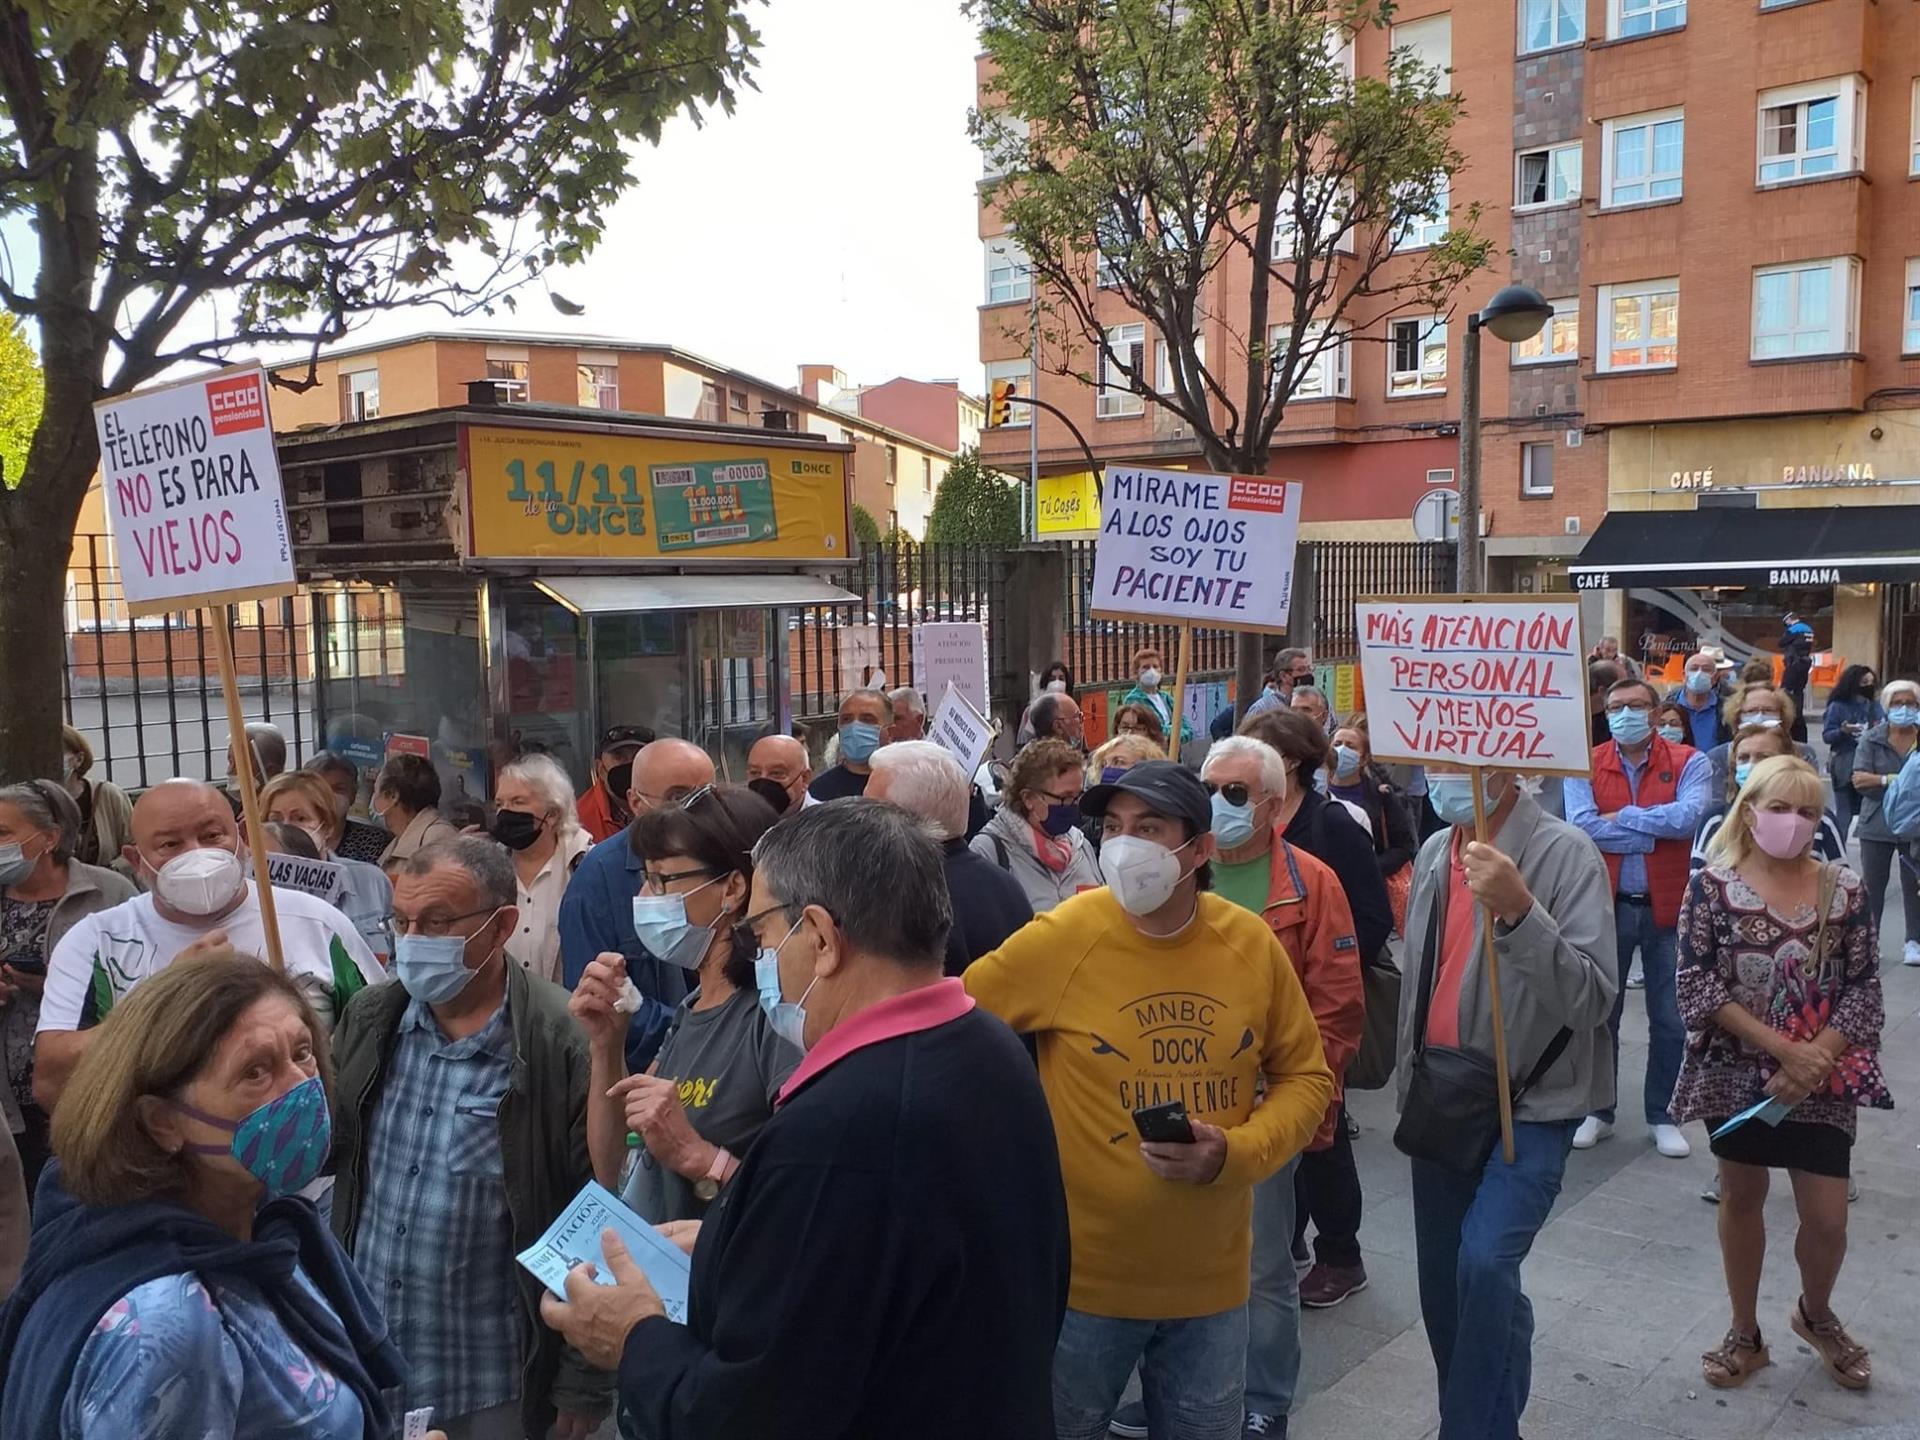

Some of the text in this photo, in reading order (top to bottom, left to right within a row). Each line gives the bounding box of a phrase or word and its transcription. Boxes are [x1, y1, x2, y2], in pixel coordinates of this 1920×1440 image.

[210, 387, 259, 411] CCOO
[104, 411, 125, 438] EL
[214, 408, 261, 425] pensionistas
[104, 415, 207, 471] TELÉFONO
[505, 458, 645, 505] 11/11
[803, 461, 832, 475] ONCE
[1670, 463, 1874, 489] CAFÉ BANDANA
[116, 448, 260, 517] NO ES PARA
[1113, 472, 1219, 511] MÍRAME
[1232, 480, 1283, 497] CCOO
[524, 491, 560, 516] de la
[1231, 494, 1282, 507] pensionistas
[547, 504, 647, 536] ONCE
[1105, 508, 1247, 544] A LOS OJOS
[132, 509, 242, 578] VIEJOS
[1150, 546, 1247, 572] SOY TU
[1112, 565, 1253, 610] PACIENTE
[1576, 569, 1840, 589] CAFÉ BANDANA
[1366, 609, 1574, 651] MÁS ATENCIÓN
[1390, 656, 1562, 698] PERSONAL
[1406, 695, 1538, 730] Y MENOS
[1393, 721, 1554, 760] VIRTUAL
[294, 865, 336, 890] VACÍAS
[1136, 1000, 1215, 1028] MNBC
[1152, 1037, 1208, 1064] DOCK
